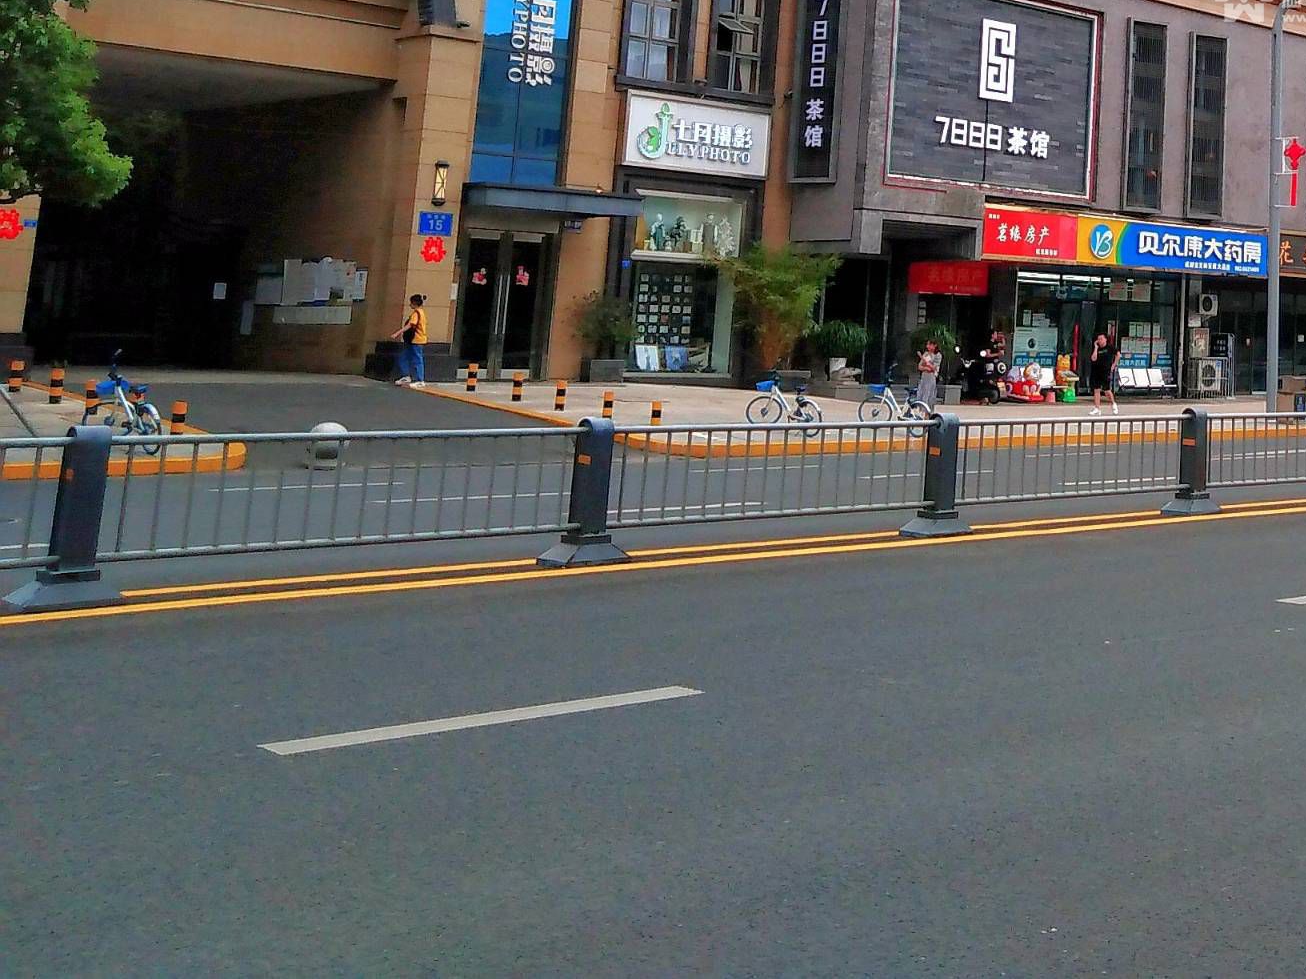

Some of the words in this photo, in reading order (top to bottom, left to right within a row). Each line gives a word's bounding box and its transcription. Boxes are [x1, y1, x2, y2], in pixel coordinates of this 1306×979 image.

[672, 119, 753, 150] 七月摄影
[429, 220, 443, 231] 15
[1138, 231, 1262, 264] 贝尔康大药房
